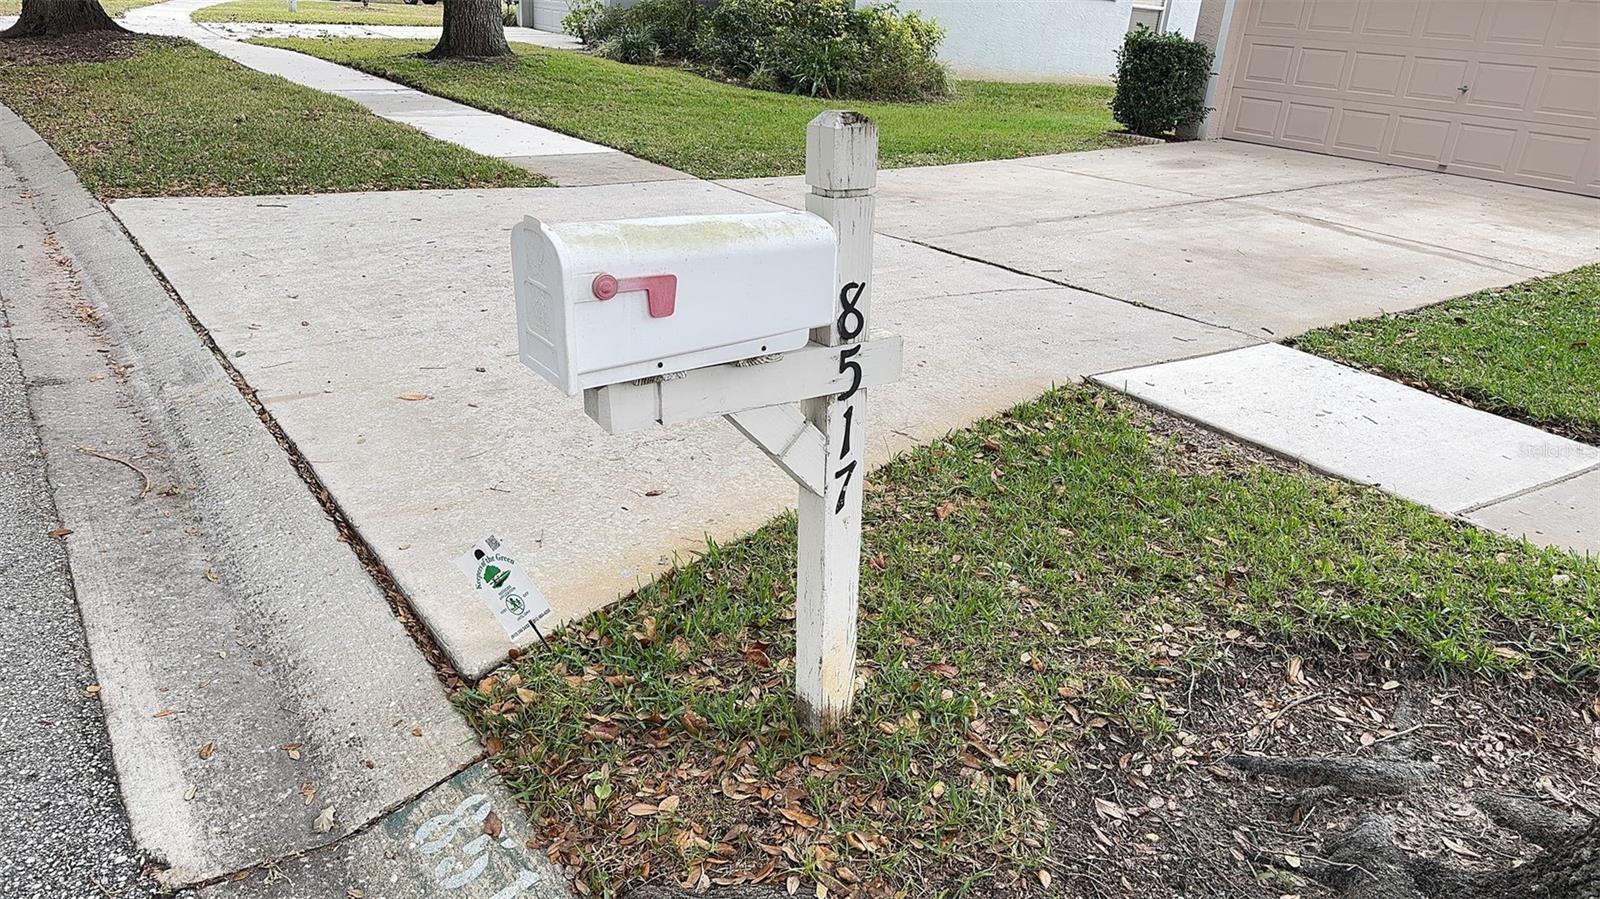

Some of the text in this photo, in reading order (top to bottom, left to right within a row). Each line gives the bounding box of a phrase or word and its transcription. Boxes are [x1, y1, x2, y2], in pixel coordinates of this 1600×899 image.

[835, 282, 866, 515] 8517
[485, 555, 495, 564] the
[495, 553, 515, 565] Green
